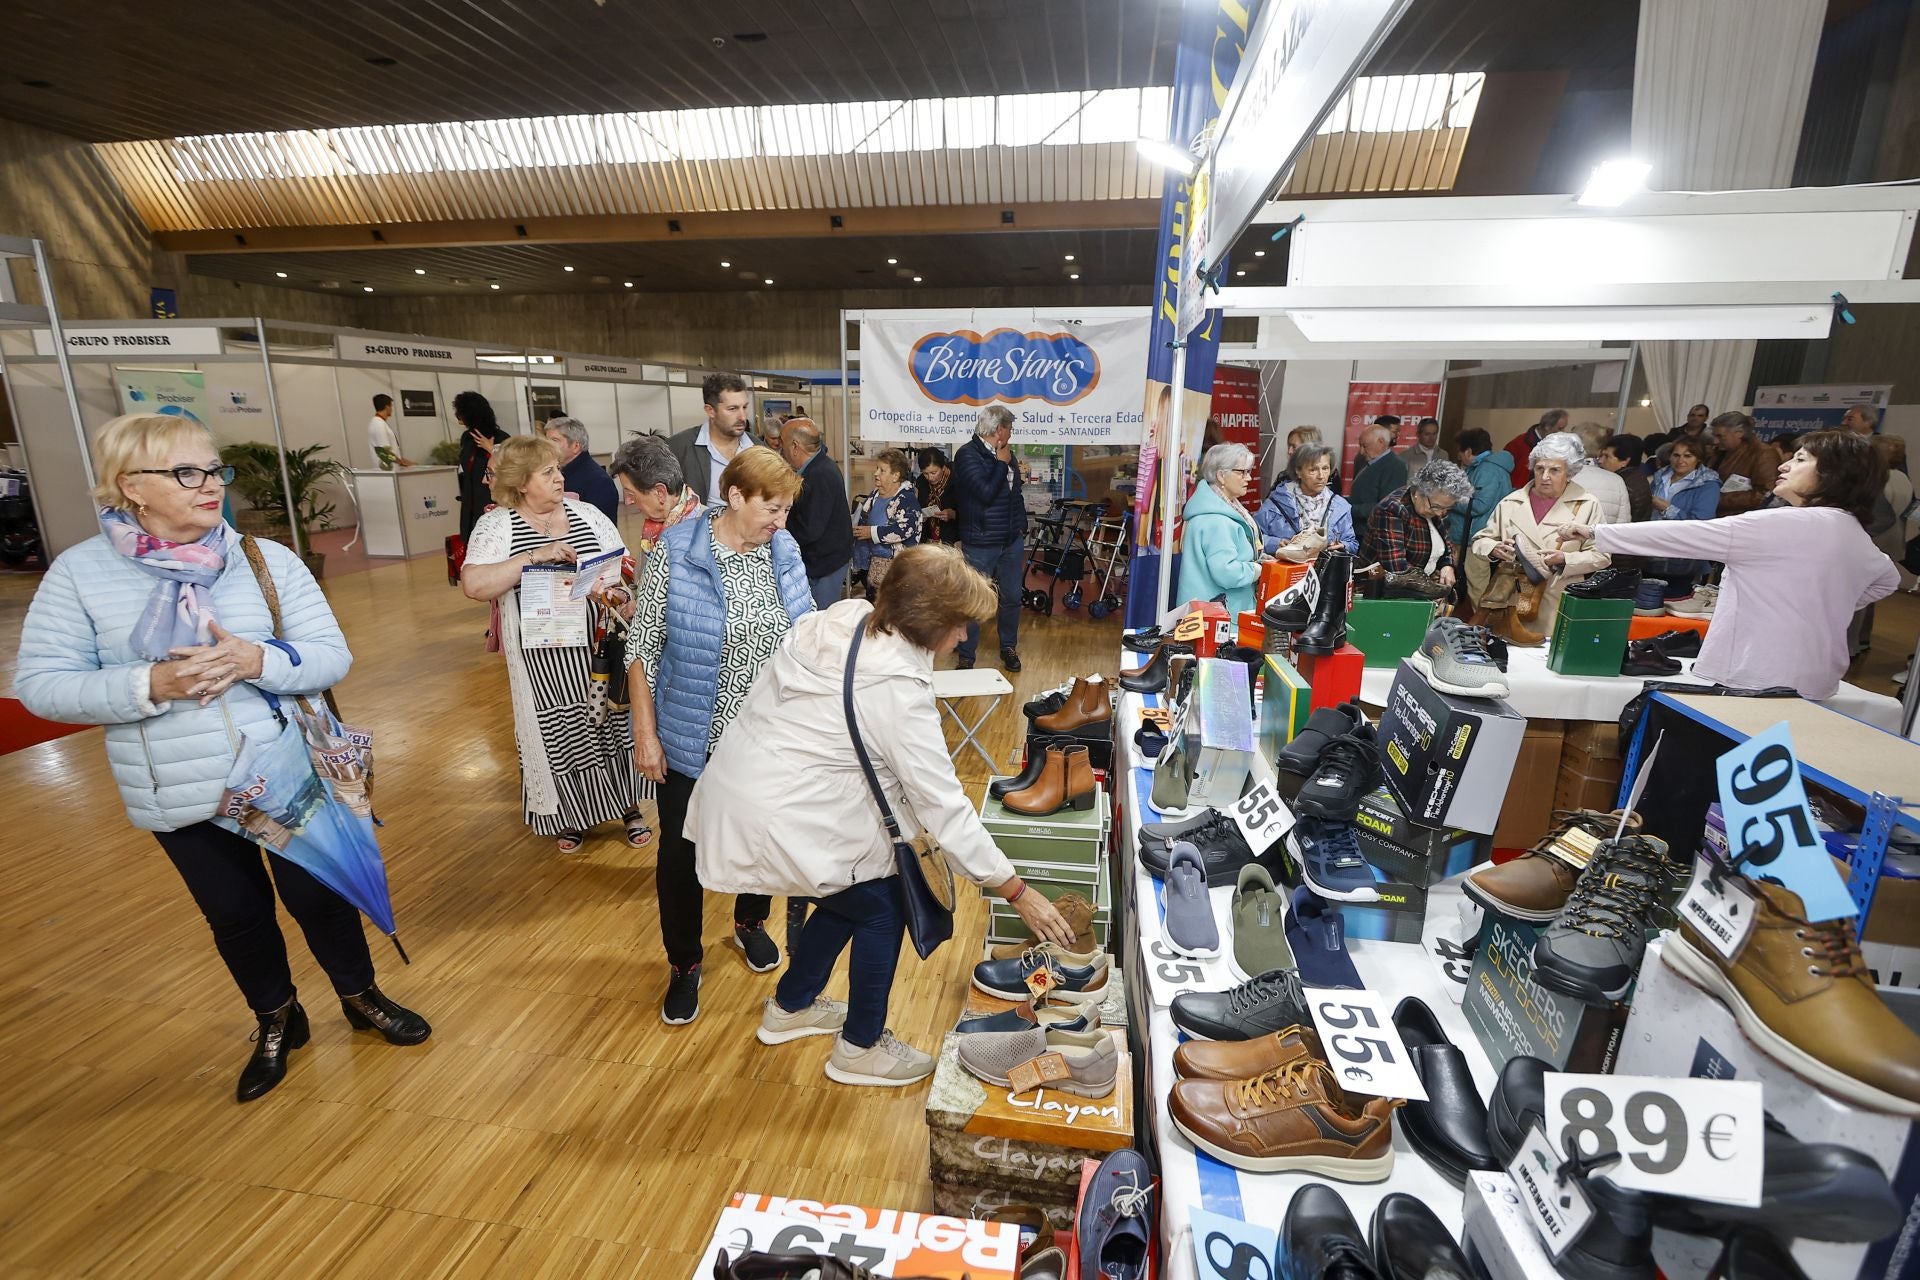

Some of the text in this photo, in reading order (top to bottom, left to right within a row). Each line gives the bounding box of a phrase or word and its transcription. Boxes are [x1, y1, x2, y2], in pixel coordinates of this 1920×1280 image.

[113, 335, 171, 346] PROBISER
[412, 348, 453, 360] PROBISER
[869, 409, 922, 424] Ortopedia
[939, 411, 981, 424] Depend
[1022, 411, 1053, 424] Salud
[1071, 412, 1112, 424] Tercera
[1116, 411, 1144, 424] Edad
[899, 424, 956, 435] TORRELAVEGA
[1058, 426, 1111, 436] SANTANDER
[1221, 413, 1260, 428] MAPFRE
[1303, 570, 1318, 603] 59
[1396, 683, 1438, 736] SKECHERS
[1423, 767, 1447, 819] SKECHERS
[1355, 811, 1393, 836] FOAM
[1364, 806, 1397, 825] SPORT
[1378, 838, 1417, 860] COMPANY
[1686, 896, 1734, 945] IMPERMEABLE
[1512, 930, 1531, 956] RELA
[1491, 922, 1566, 1040] SKECHERS
[1478, 983, 1516, 1043] MEMORY
[1480, 971, 1498, 998] WITH
[1497, 997, 1536, 1057] AIR-COO
[1487, 943, 1560, 1057] OUTDOOR
[1608, 1027, 1621, 1053] FOAM
[1006, 1088, 1120, 1125] Clayan
[1518, 1162, 1562, 1238] IMPERMEABLE
